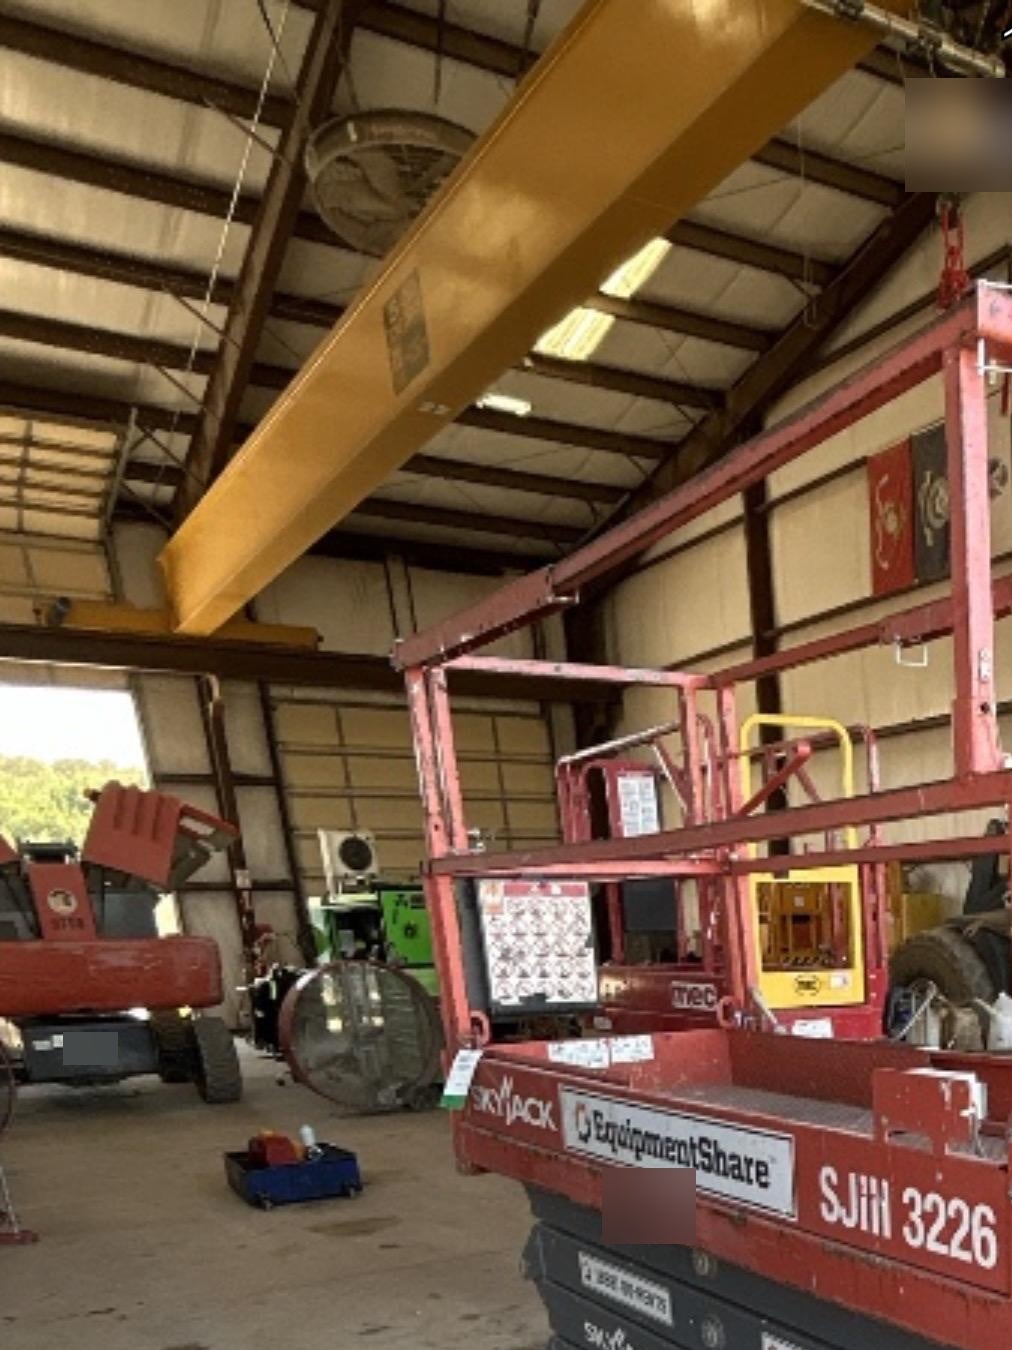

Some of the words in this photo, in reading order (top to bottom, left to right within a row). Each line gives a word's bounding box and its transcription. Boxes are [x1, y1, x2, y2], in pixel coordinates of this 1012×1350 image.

[472, 1076, 558, 1131] SKYJACK
[592, 1108, 771, 1189] EquipmentShare
[902, 1188, 998, 1270] 3226
